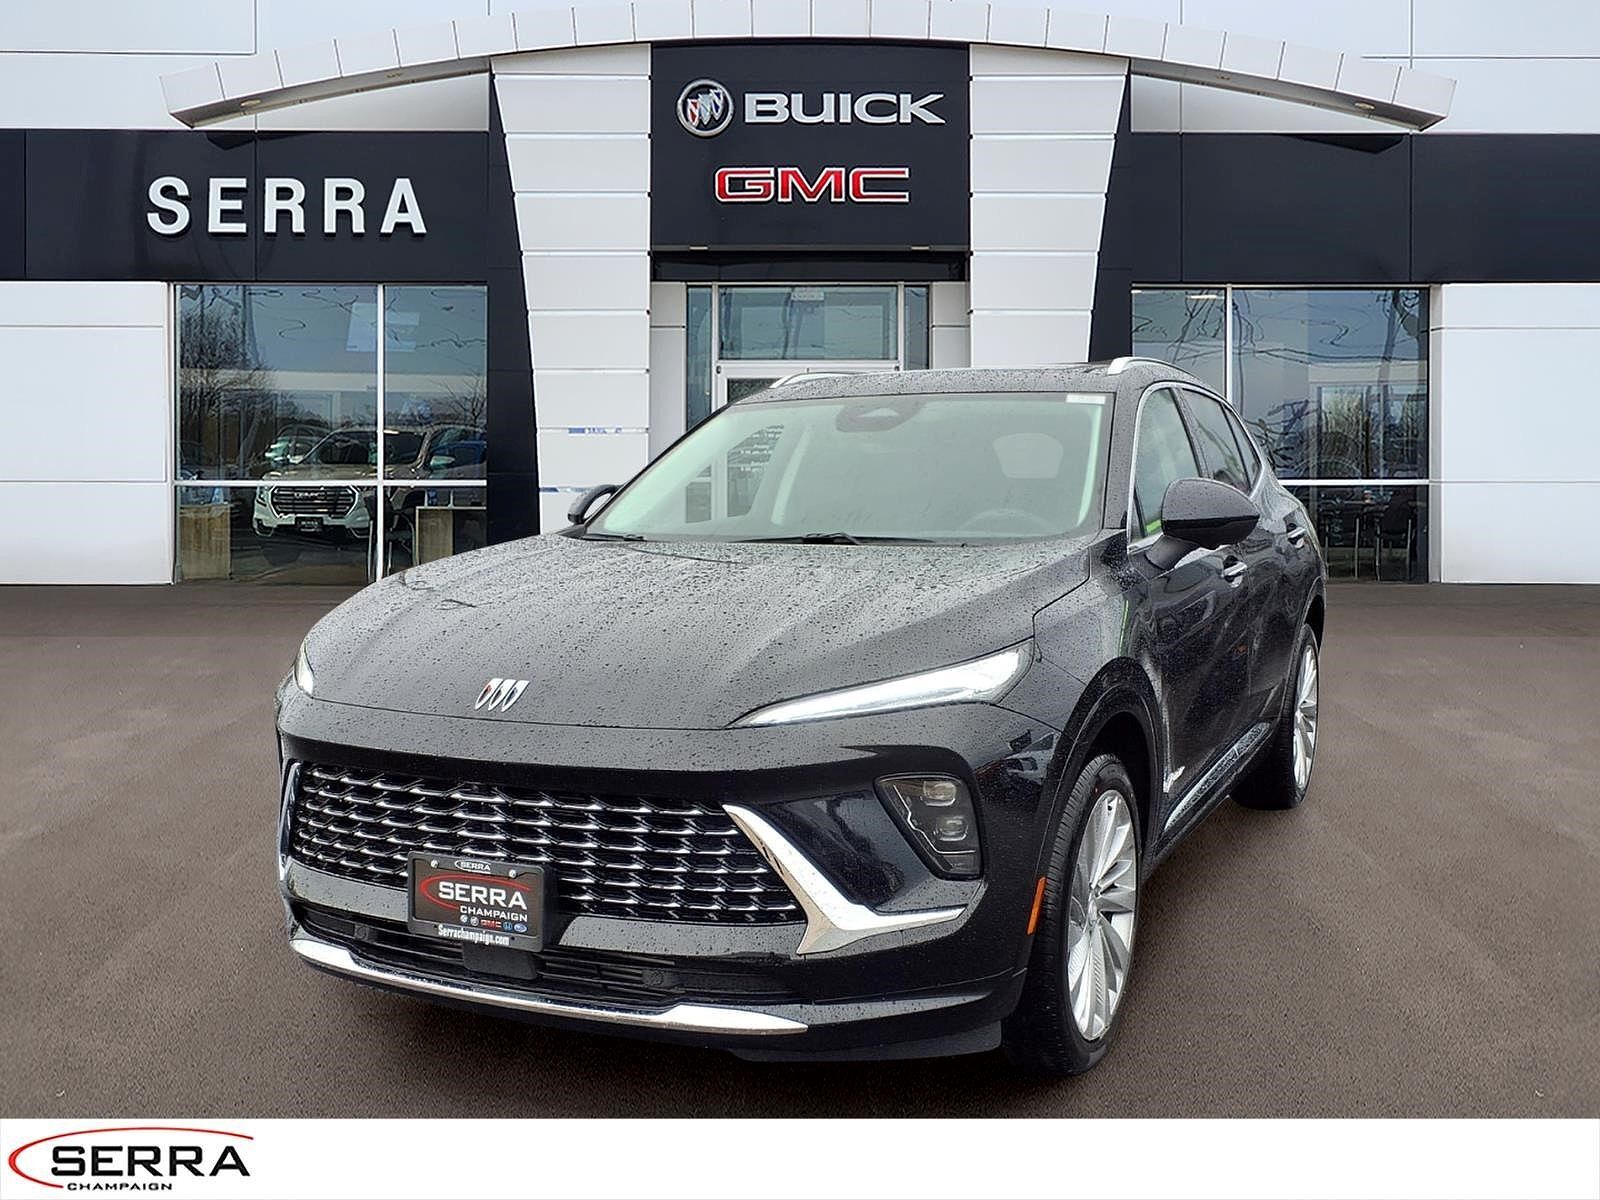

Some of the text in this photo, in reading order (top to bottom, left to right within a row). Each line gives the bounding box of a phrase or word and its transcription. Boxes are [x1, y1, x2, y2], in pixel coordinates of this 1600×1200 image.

[743, 92, 946, 124] BUICK
[714, 166, 910, 203] GMC
[147, 176, 427, 235] SERRA
[460, 861, 491, 871] SERRA
[438, 881, 528, 910] SERRA
[460, 905, 528, 922] CHAMPAIGN
[438, 923, 510, 946] Serrachampaign.com
